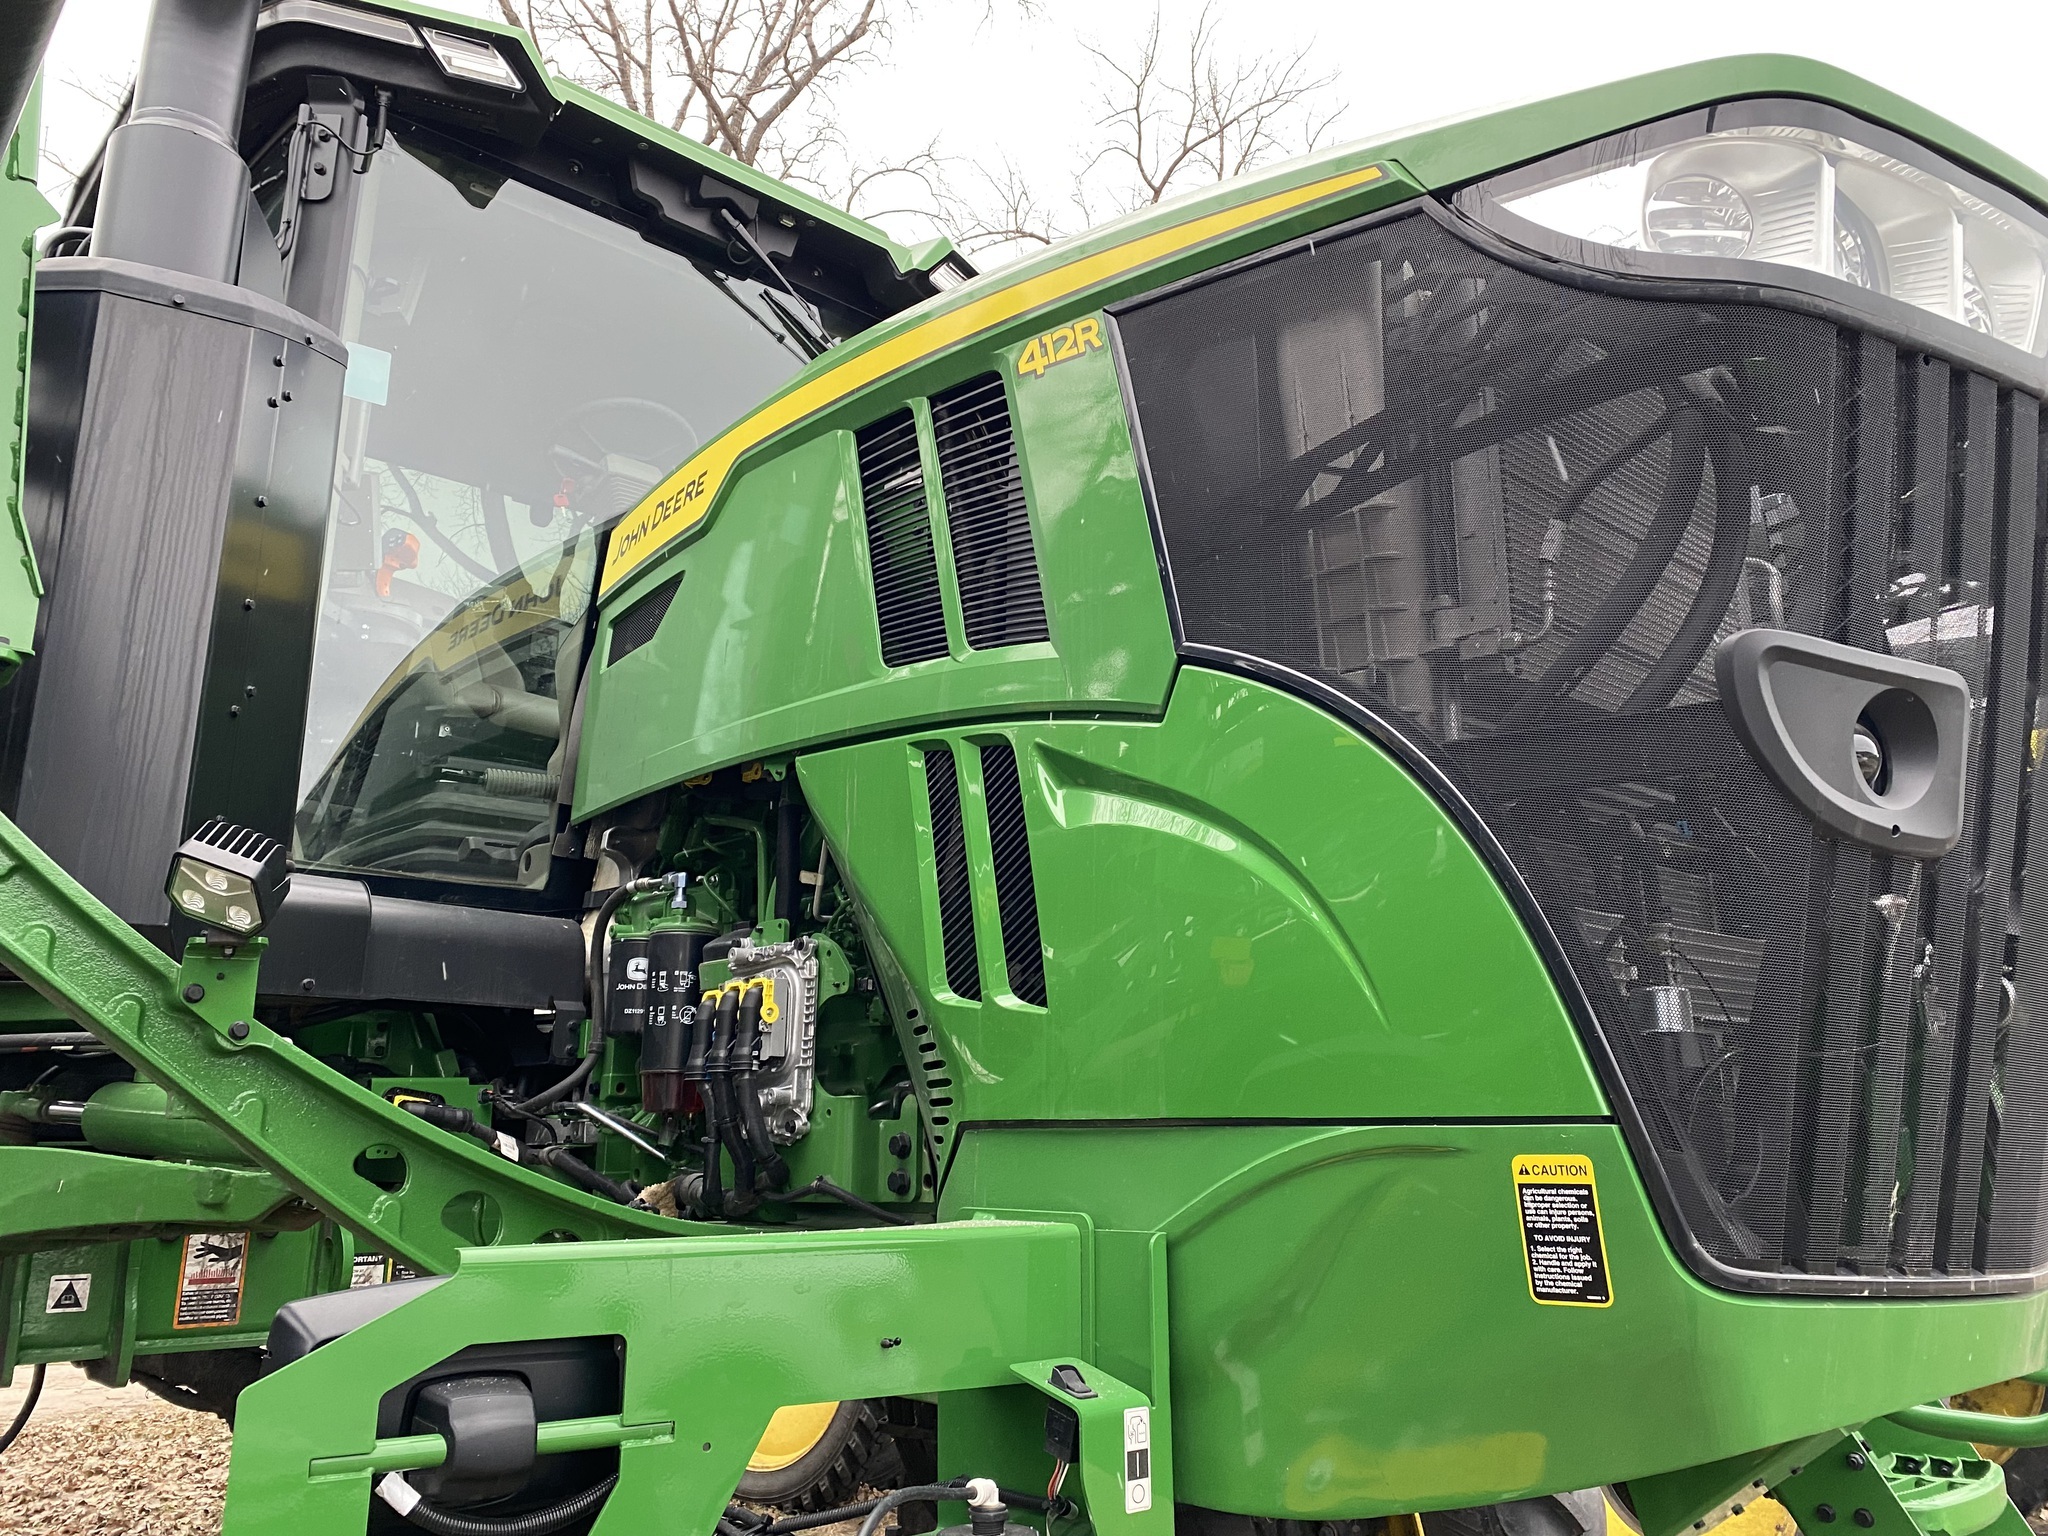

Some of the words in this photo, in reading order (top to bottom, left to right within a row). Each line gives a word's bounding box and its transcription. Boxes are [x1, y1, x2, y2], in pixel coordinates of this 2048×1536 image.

[1017, 317, 1104, 379] 412R
[612, 514, 651, 566] JOHN
[651, 469, 708, 532] DEERE
[616, 982, 636, 990] JOHN
[1532, 1165, 1587, 1176] CAUTION
